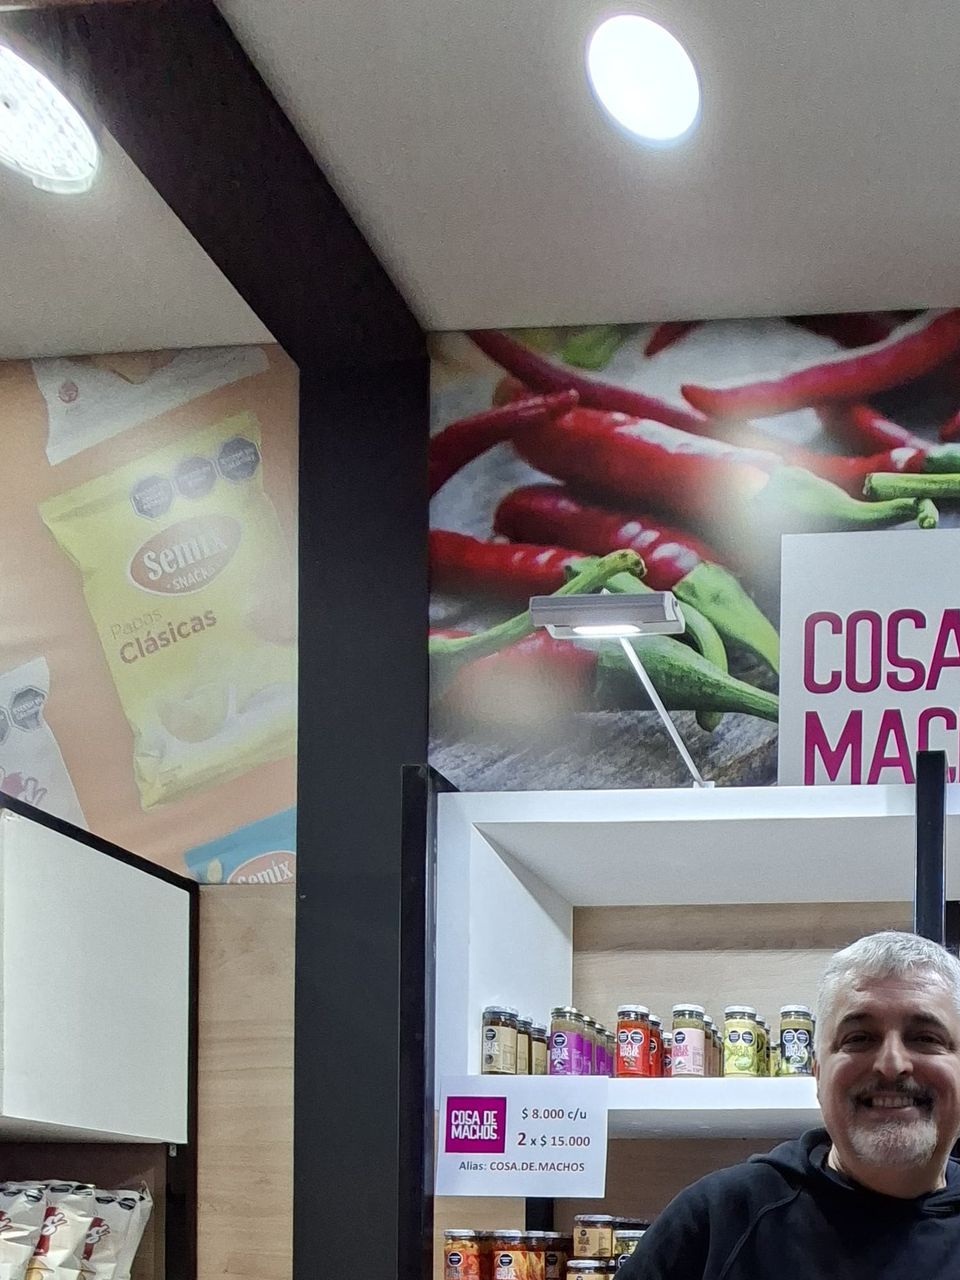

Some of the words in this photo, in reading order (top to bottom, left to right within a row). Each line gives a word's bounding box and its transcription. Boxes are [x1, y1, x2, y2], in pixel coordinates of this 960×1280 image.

[119, 609, 217, 664] Clásicas
[451, 1110, 480, 1125] COSA
[484, 1110, 498, 1125] DE
[522, 1107, 528, 1120] $
[531, 1108, 565, 1120] 8.000
[567, 1107, 587, 1121] c/u
[517, 1132, 526, 1146] 2
[530, 1138, 537, 1146] x
[540, 1134, 547, 1147] $
[550, 1136, 591, 1147] 15.000
[458, 1161, 487, 1171] Alias:
[489, 1161, 585, 1172] COSA.DE.MACHOS
